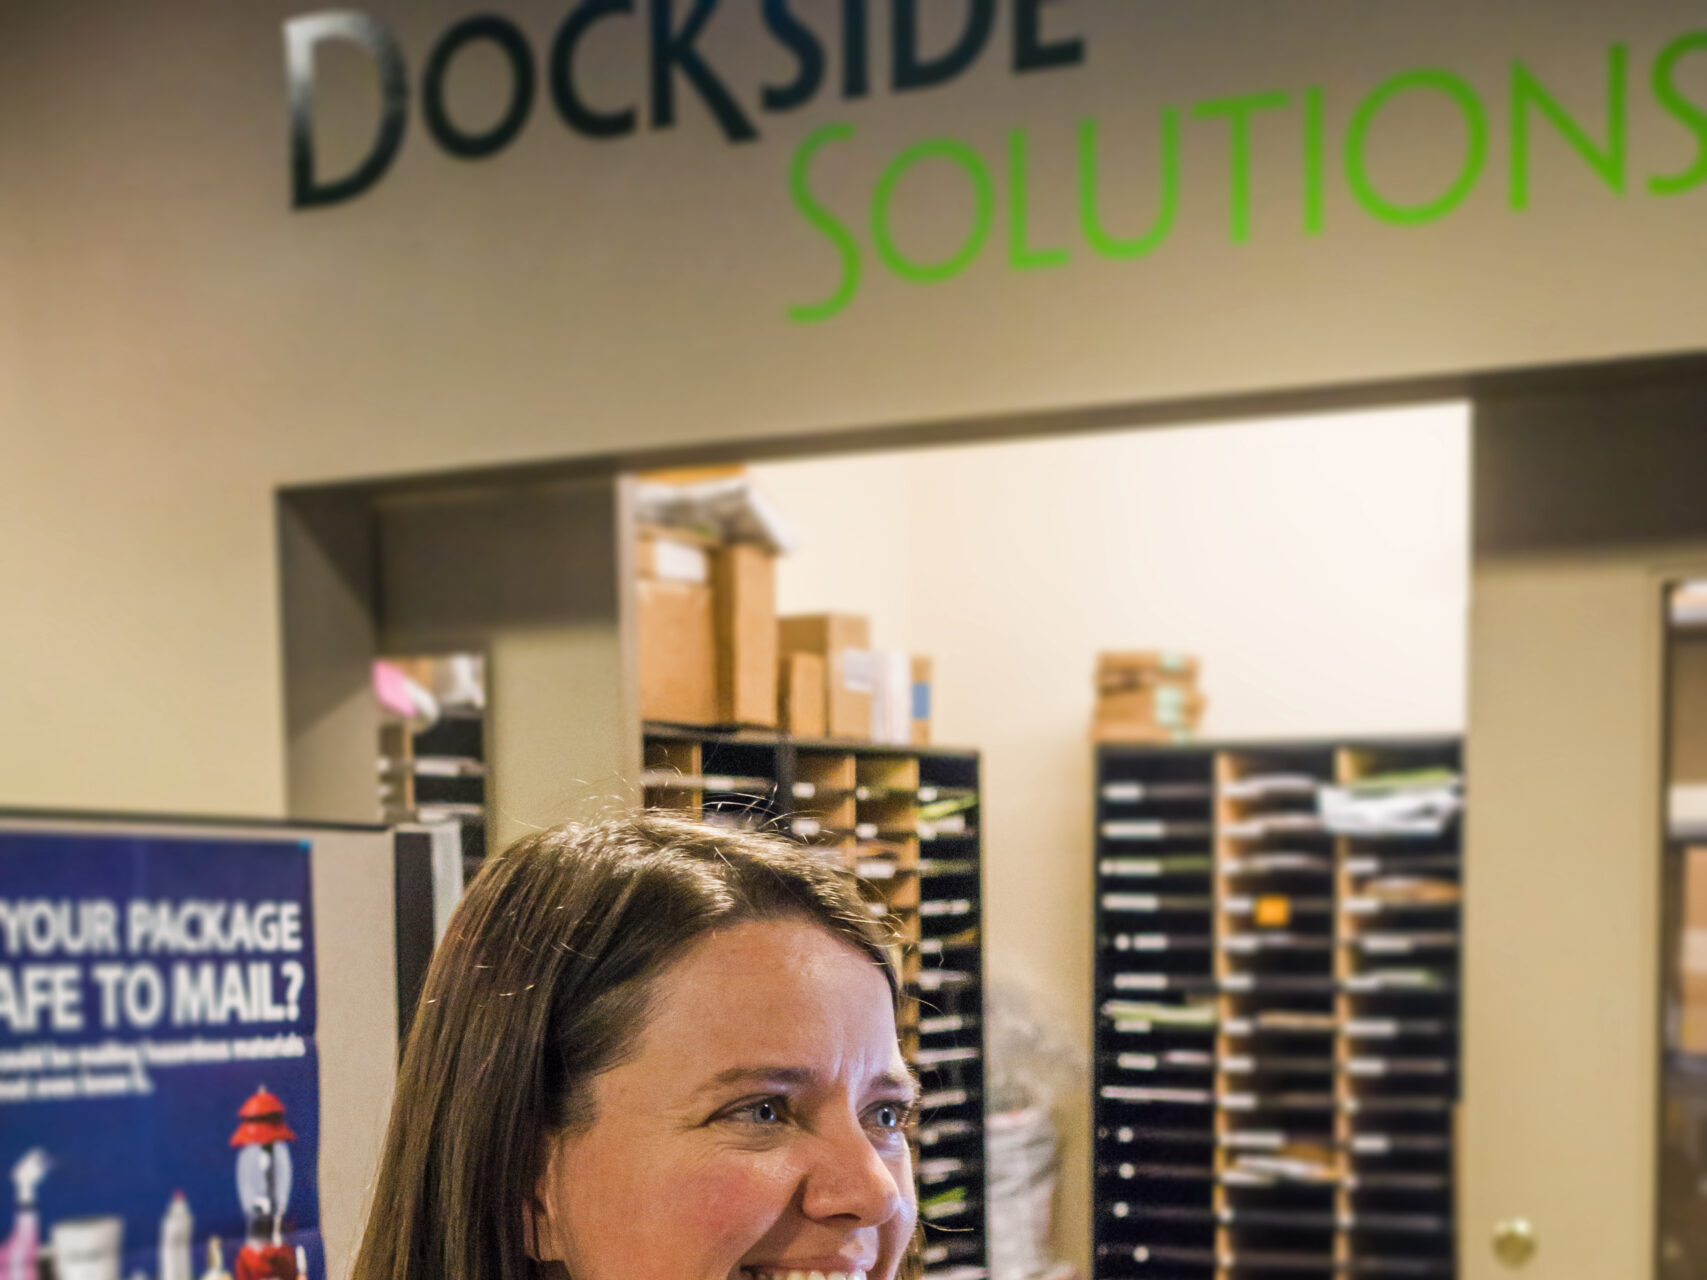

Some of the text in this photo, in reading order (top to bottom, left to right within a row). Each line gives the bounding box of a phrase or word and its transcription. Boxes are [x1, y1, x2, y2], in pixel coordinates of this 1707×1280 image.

[787, 30, 1707, 322] SOLUTIONS
[0, 902, 302, 953] YOUR PACKAGE
[92, 963, 165, 1027] TO
[172, 961, 304, 1025] MAIL?
